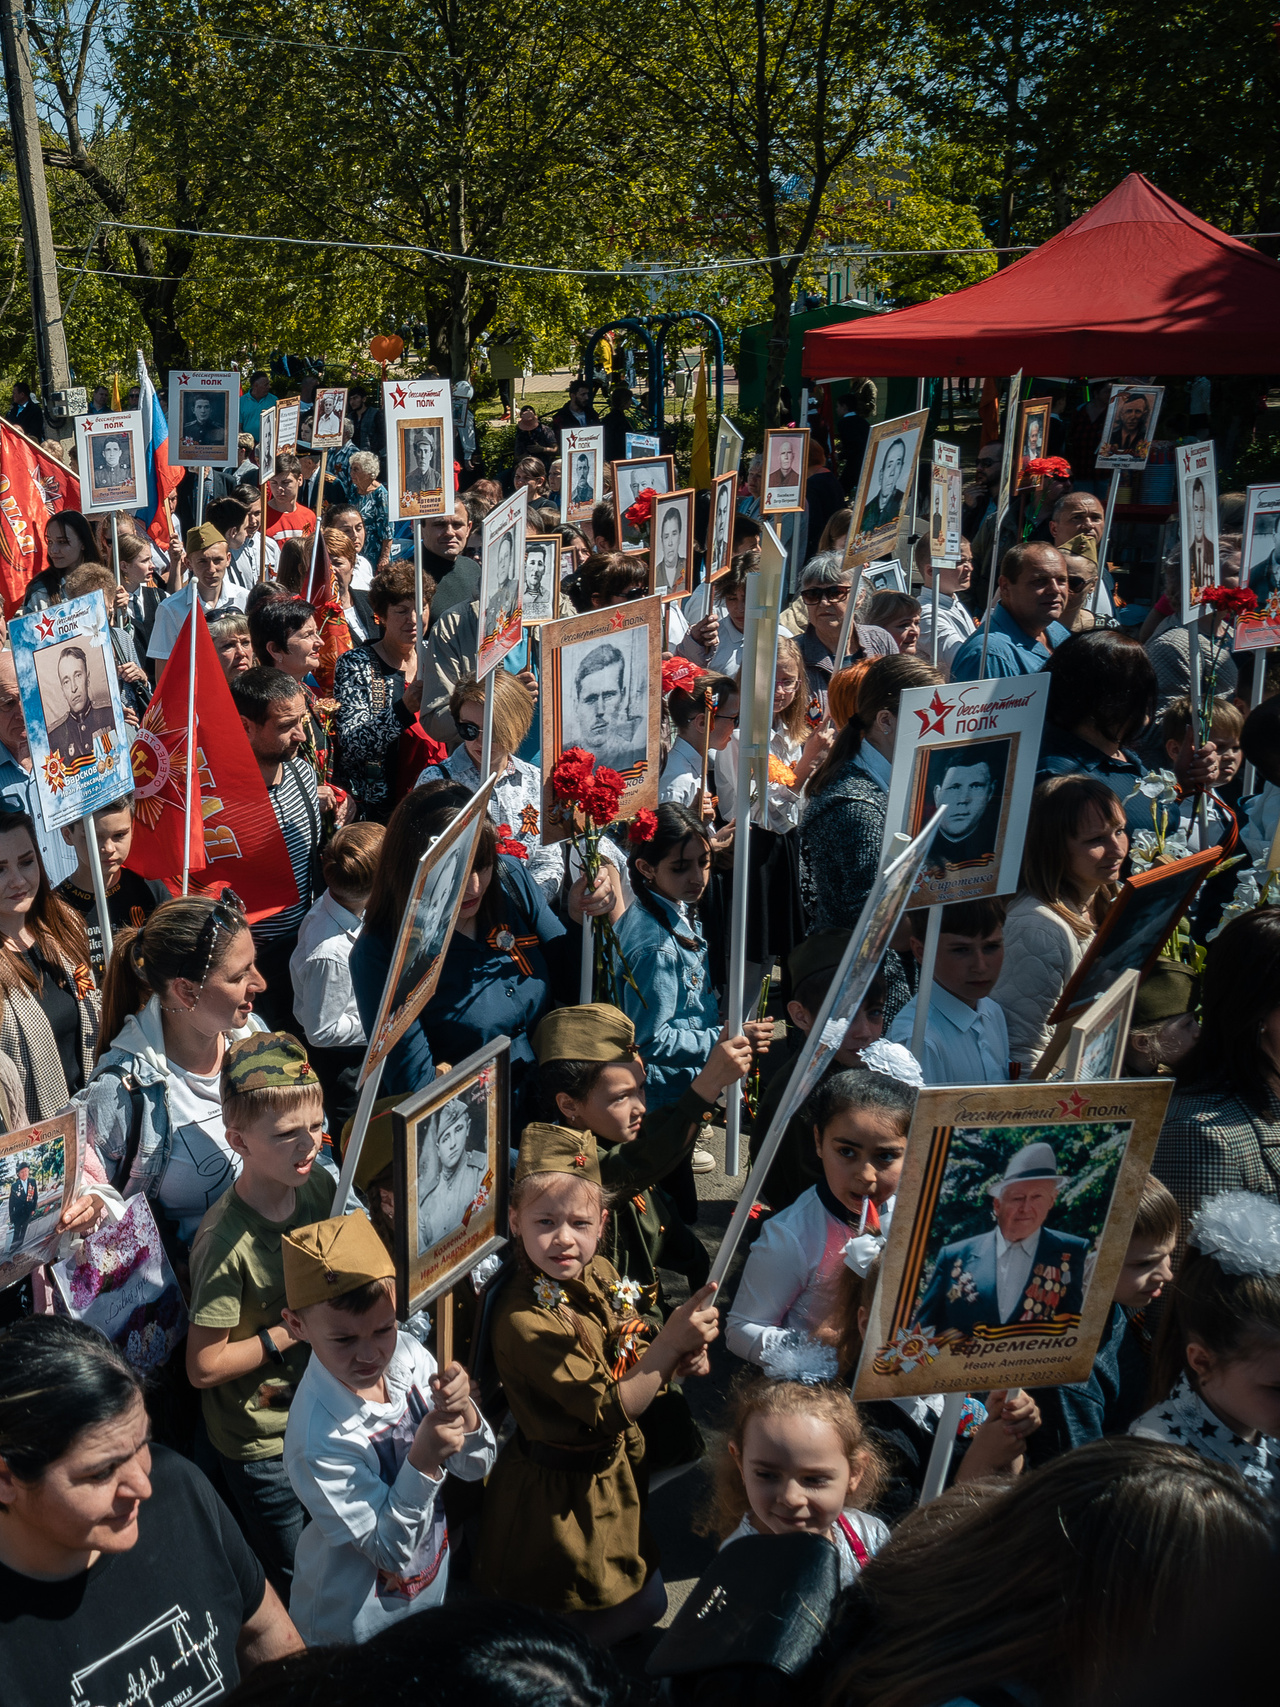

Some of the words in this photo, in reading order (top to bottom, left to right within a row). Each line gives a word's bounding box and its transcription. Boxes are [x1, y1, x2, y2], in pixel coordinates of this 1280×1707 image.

[407, 382, 443, 398] бессмертный
[416, 399, 435, 408] ПОЛК
[104, 421, 124, 429] ПОЛК
[58, 621, 79, 635] ПОЛК
[560, 621, 610, 643] бессмертный
[623, 615, 645, 627] ПОЛК
[957, 687, 1037, 716] бессмертный
[955, 716, 998, 734] ПОЛК
[64, 765, 98, 786] Барсков
[930, 874, 993, 891] Сиротенко
[954, 1093, 1056, 1123] бессмертный
[1086, 1104, 1127, 1117] ПОЛК
[42, 1128, 61, 1139] ПОЛК
[433, 1230, 467, 1260] Козленок
[420, 1263, 439, 1281] Иван
[441, 1231, 479, 1266] Андреевич
[950, 1336, 1078, 1358] Ефременко
[963, 1361, 995, 1371] Иван
[998, 1356, 1073, 1368] Антонович
[172, 1611, 218, 1681] Angel
[173, 1686, 193, 1706] SELF
